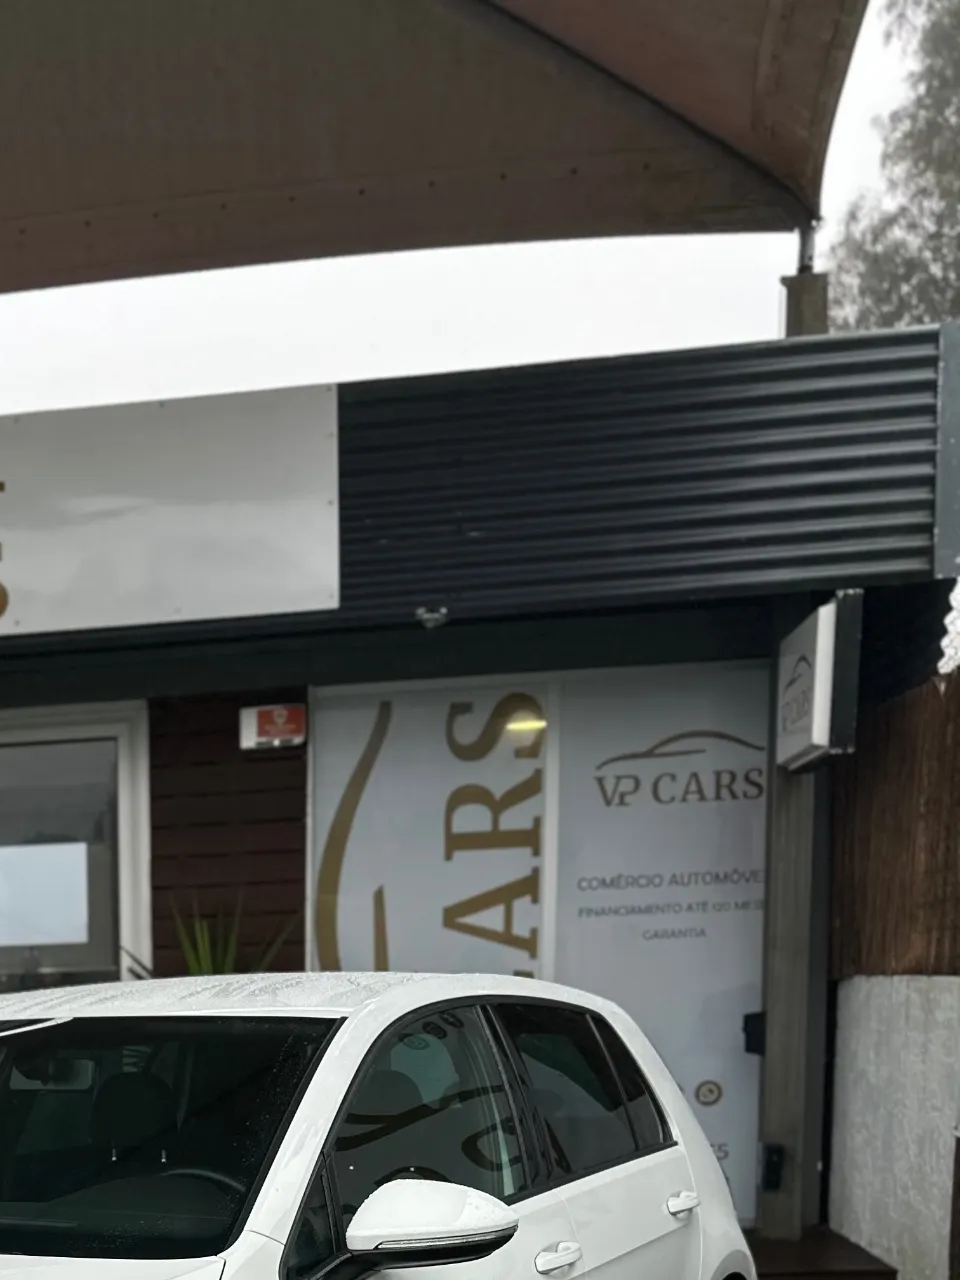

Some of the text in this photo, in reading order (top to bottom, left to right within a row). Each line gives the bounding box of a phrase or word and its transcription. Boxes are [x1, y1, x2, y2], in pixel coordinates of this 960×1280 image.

[442, 692, 548, 980] ARS
[594, 767, 764, 807] VP CARS
